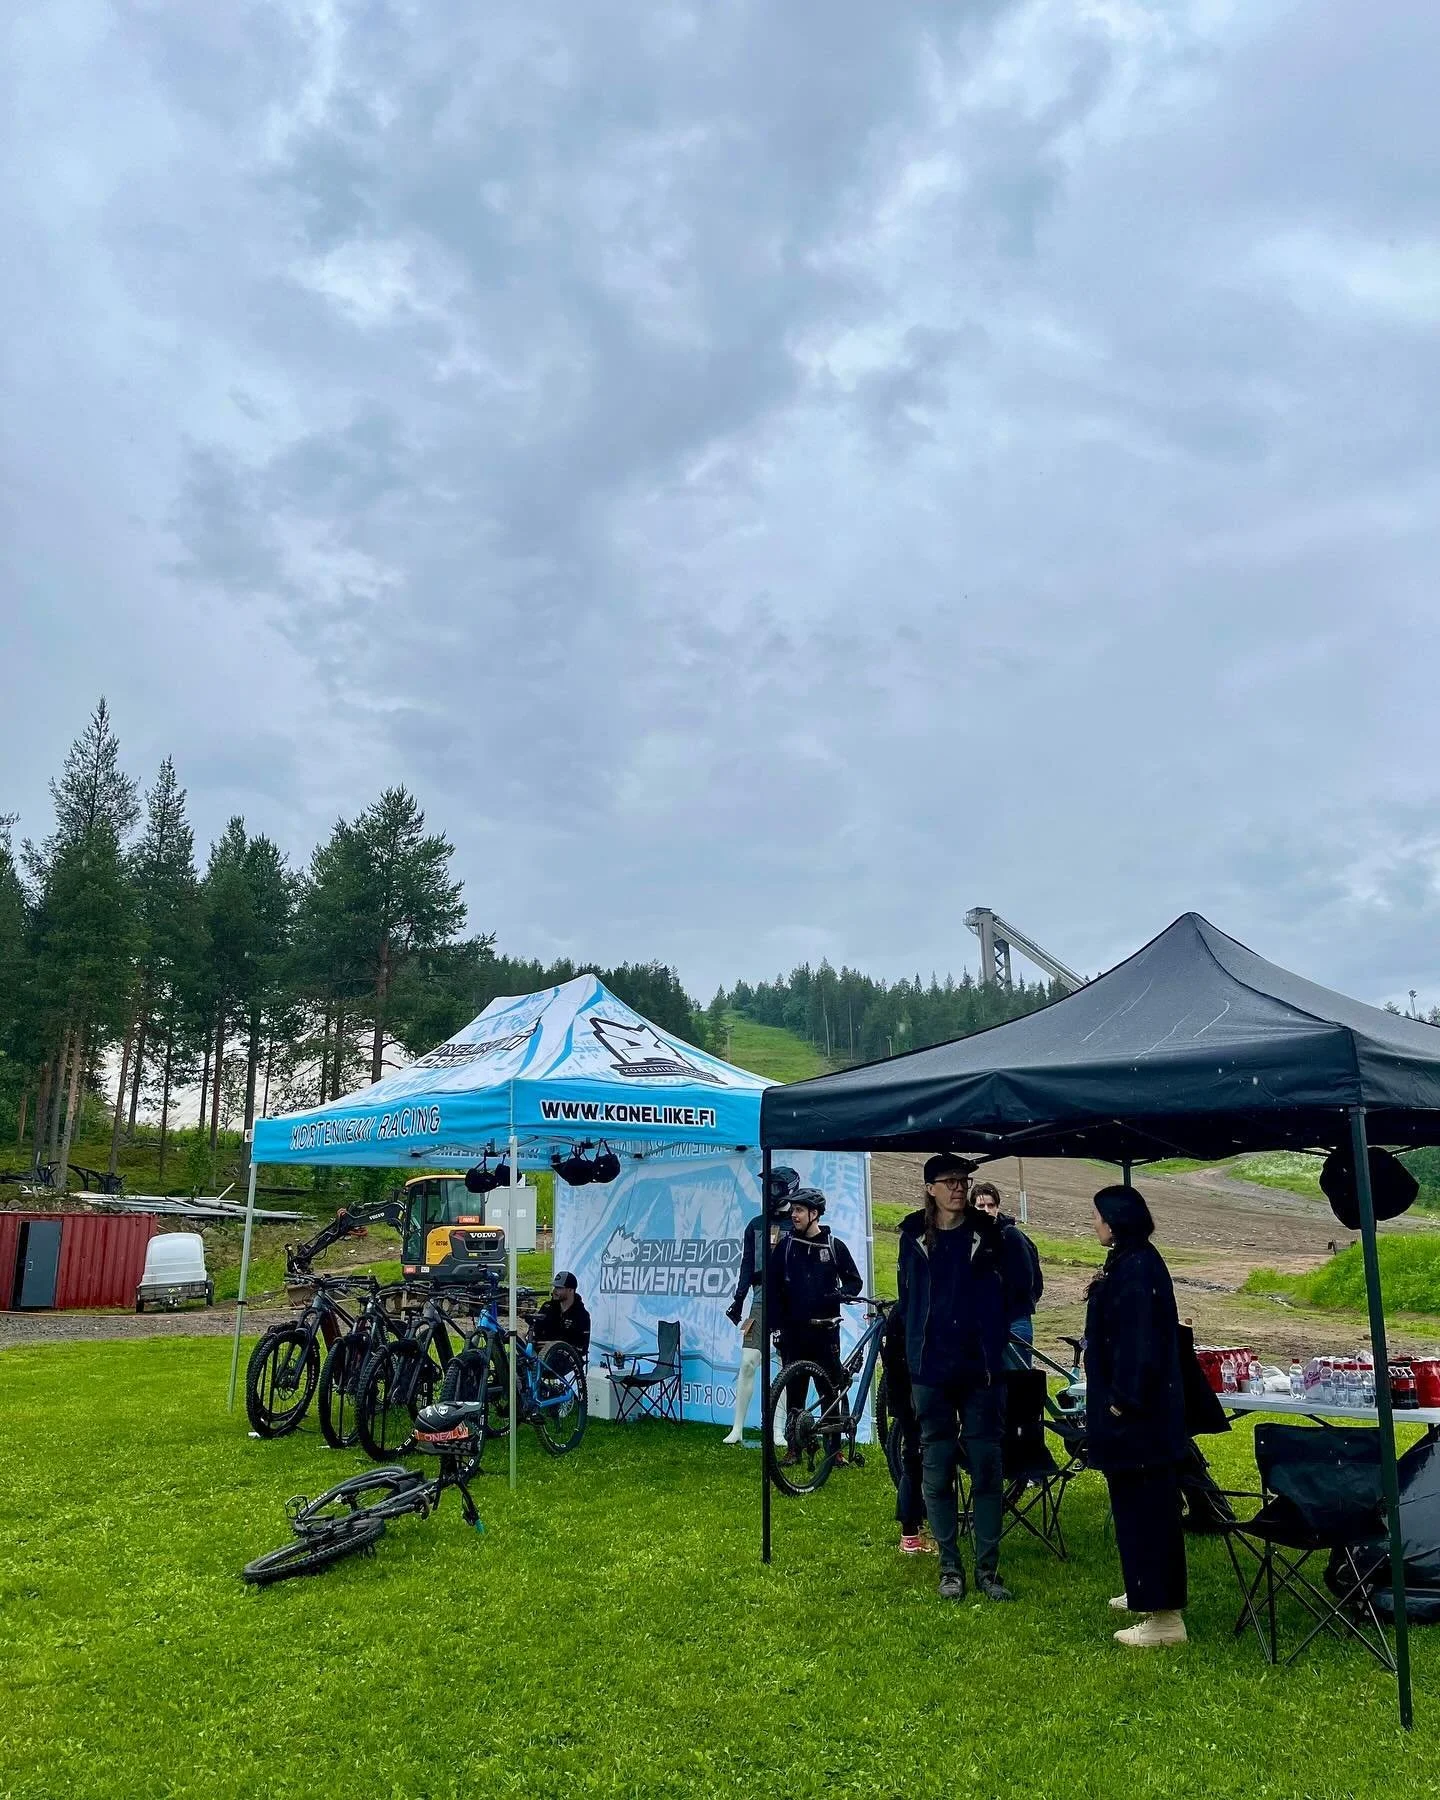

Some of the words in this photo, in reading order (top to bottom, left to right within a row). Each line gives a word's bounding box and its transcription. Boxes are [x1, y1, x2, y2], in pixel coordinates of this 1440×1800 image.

[290, 1116, 377, 1150] KORTENIEMI
[377, 1104, 441, 1140] RACING
[540, 1099, 717, 1128] WWW.KONELIIKE.FI
